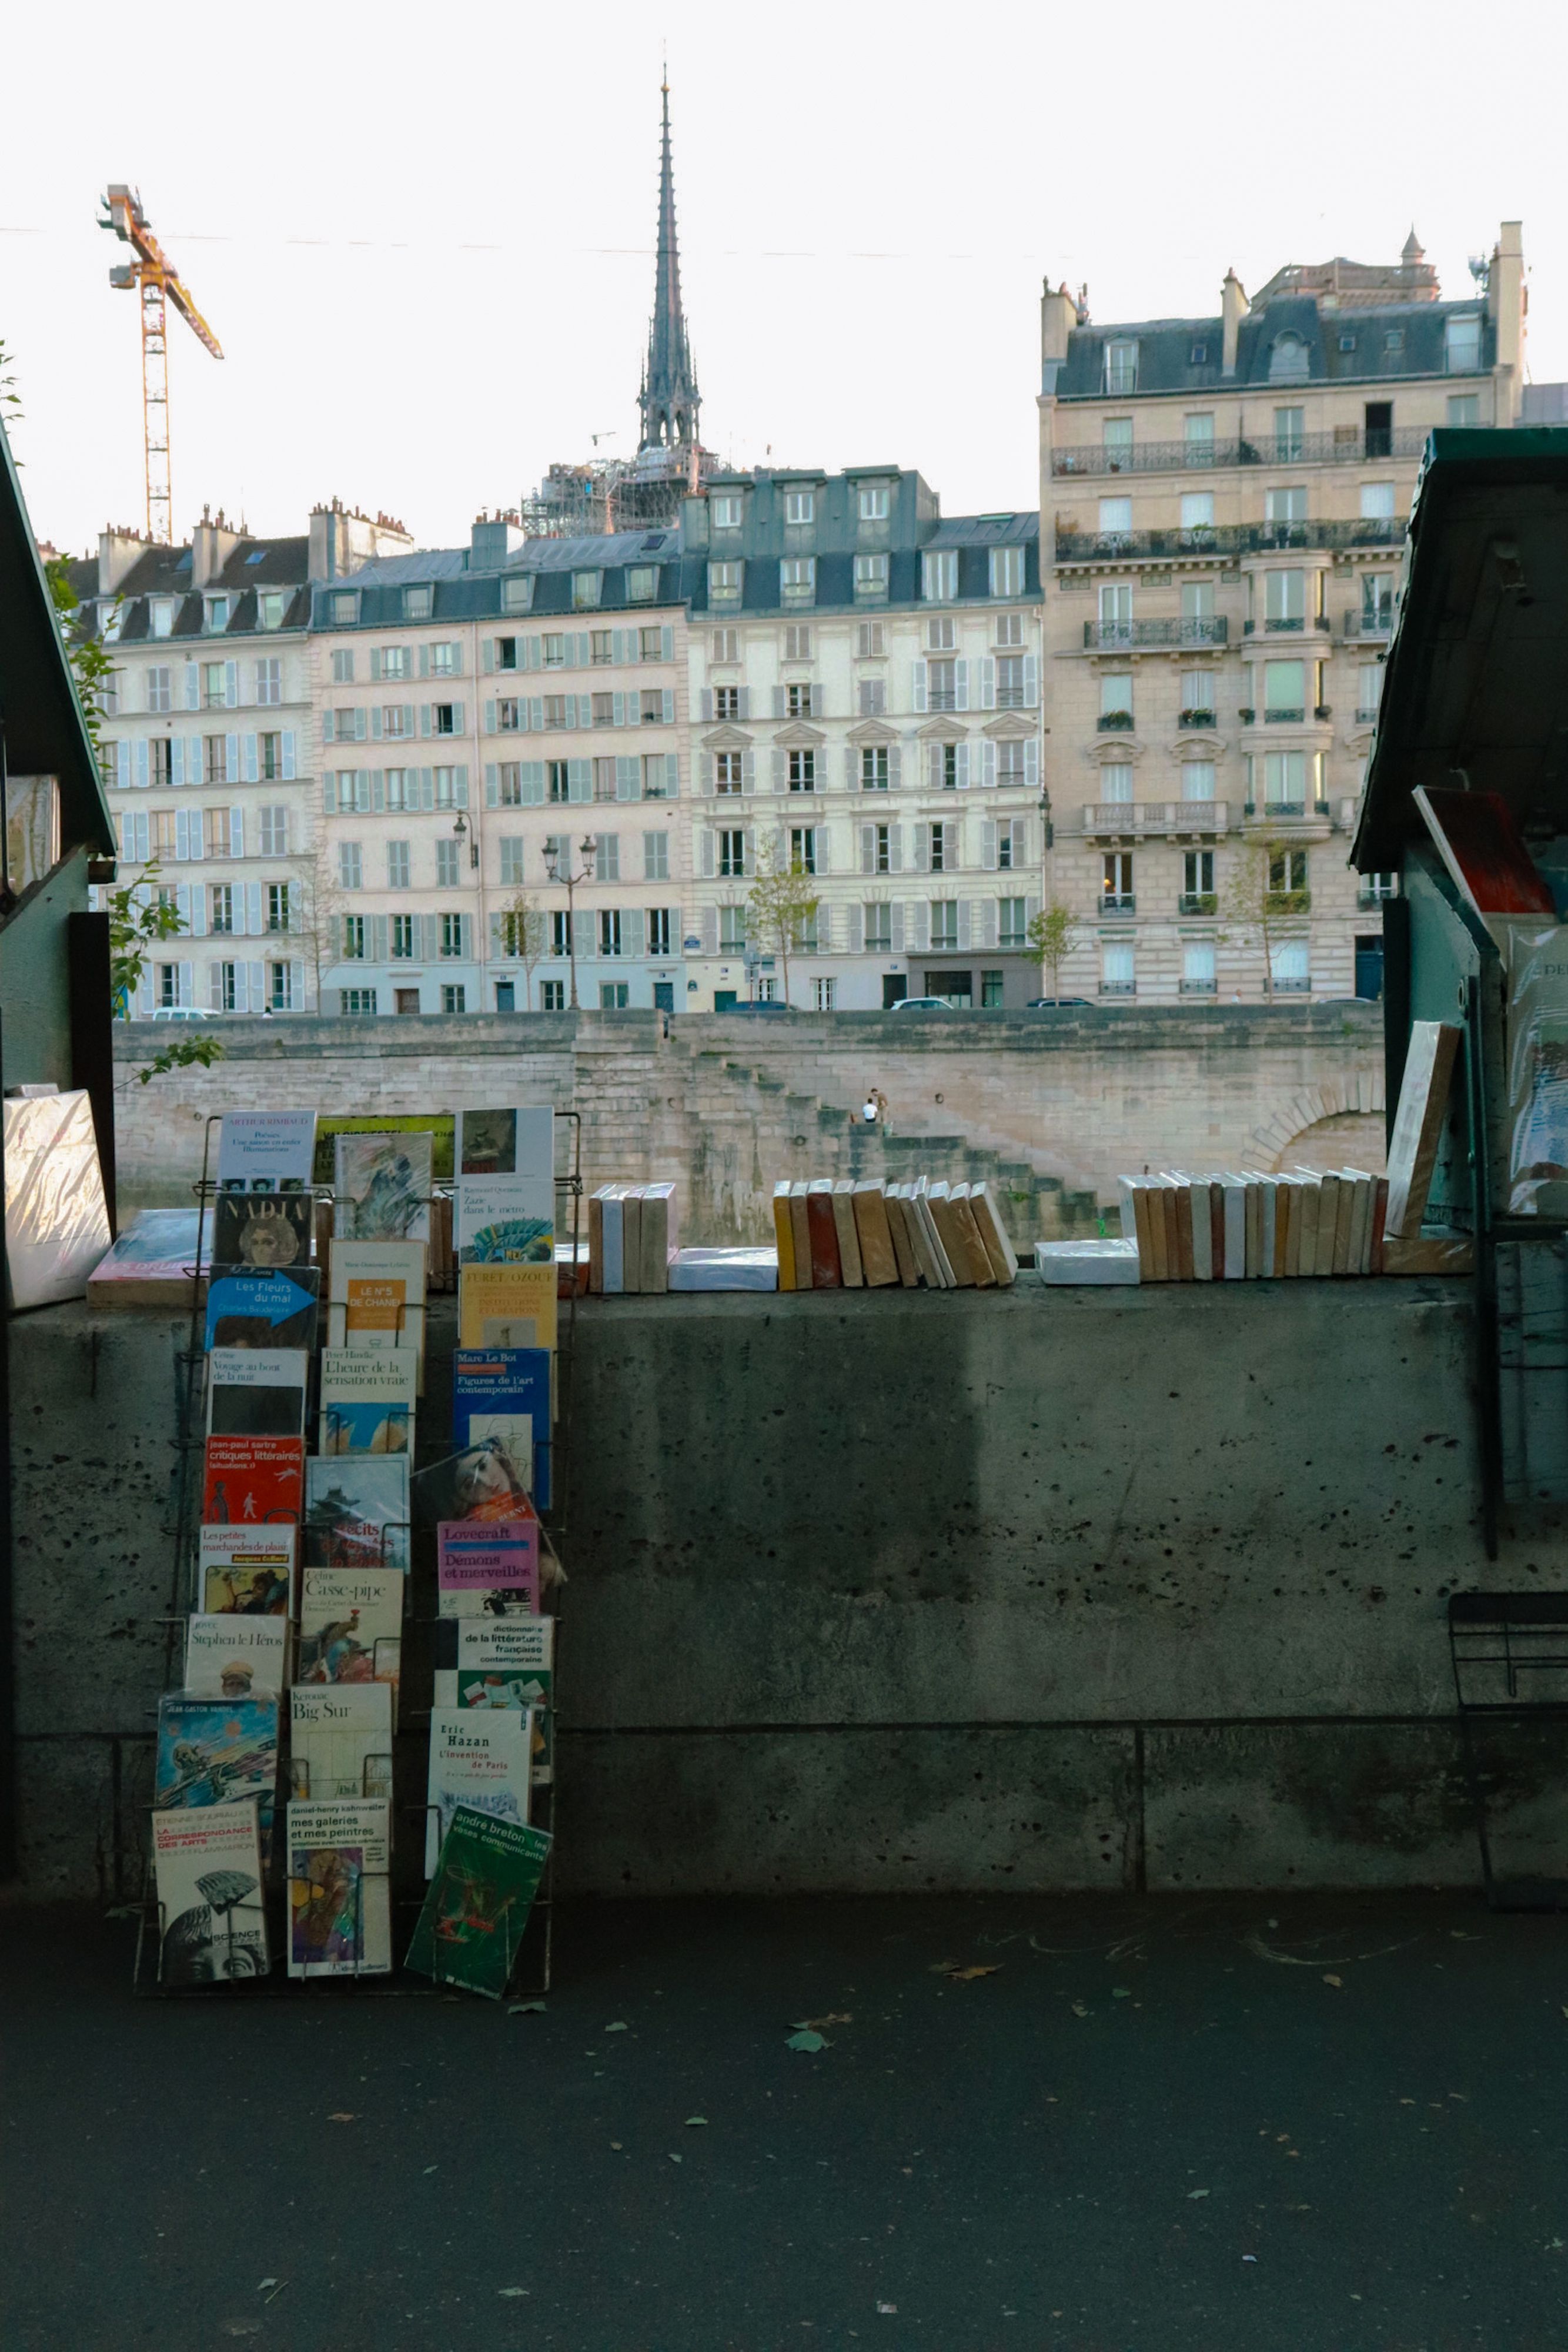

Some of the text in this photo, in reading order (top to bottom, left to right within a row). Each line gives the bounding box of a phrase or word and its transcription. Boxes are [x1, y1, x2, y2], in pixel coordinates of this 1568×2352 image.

[1544, 964, 1568, 975] DE
[230, 1117, 309, 1126] ARTHUR RIMBAUD
[464, 1195, 486, 1205] Zazie
[226, 1200, 305, 1221] NADJA
[463, 1205, 525, 1214] dans le métro
[467, 1272, 505, 1283] FURET
[236, 1281, 292, 1293] Les Fleurs
[360, 1287, 372, 1296] LE
[254, 1293, 292, 1304] du mal
[350, 1298, 363, 1307] DE
[345, 1351, 375, 1359] Handke
[457, 1353, 517, 1363] Marc Le Bot
[214, 1361, 243, 1372] Voyage
[260, 1362, 280, 1372] bout
[325, 1361, 399, 1373] L'heure de la
[213, 1372, 255, 1381] de la nuit
[324, 1374, 409, 1386] sensation vraie
[457, 1377, 534, 1387] Figures de l'art
[457, 1386, 524, 1395] contemporain
[210, 1440, 249, 1449] jean-paul
[209, 1449, 300, 1462] critiques littéraires
[203, 1530, 246, 1541] Les petites
[444, 1526, 511, 1540] Lovecraft
[203, 1541, 253, 1552] marchandes
[254, 1541, 263, 1552] de
[444, 1553, 502, 1566] Démons
[306, 1570, 334, 1581] Céline
[444, 1565, 531, 1578] et merveilles
[306, 1579, 386, 1601] Casse-pipe
[494, 1625, 543, 1633] dictionnaie
[192, 1632, 283, 1648] Stephen le Héros
[466, 1633, 543, 1643] de la littérature
[495, 1644, 543, 1655] française
[480, 1655, 543, 1664] contemporaine
[293, 1691, 329, 1701] Kerouac
[294, 1701, 352, 1723] Big Sur
[441, 1725, 464, 1734] Eric
[447, 1735, 490, 1747] Hazan
[439, 1750, 490, 1760] L'invention
[472, 1760, 508, 1770] de Paris
[291, 1803, 386, 1815] daniel-henry kahnweiler
[291, 1816, 359, 1829] mes galeries
[158, 1826, 253, 1842] CORRESPONDANCE
[291, 1827, 375, 1839] et mes peintres
[456, 1813, 549, 1852] andré breton les
[158, 1838, 208, 1849] DES ARTS
[453, 1824, 544, 1862] vases communicants
[213, 1930, 260, 1942] SCENCE
